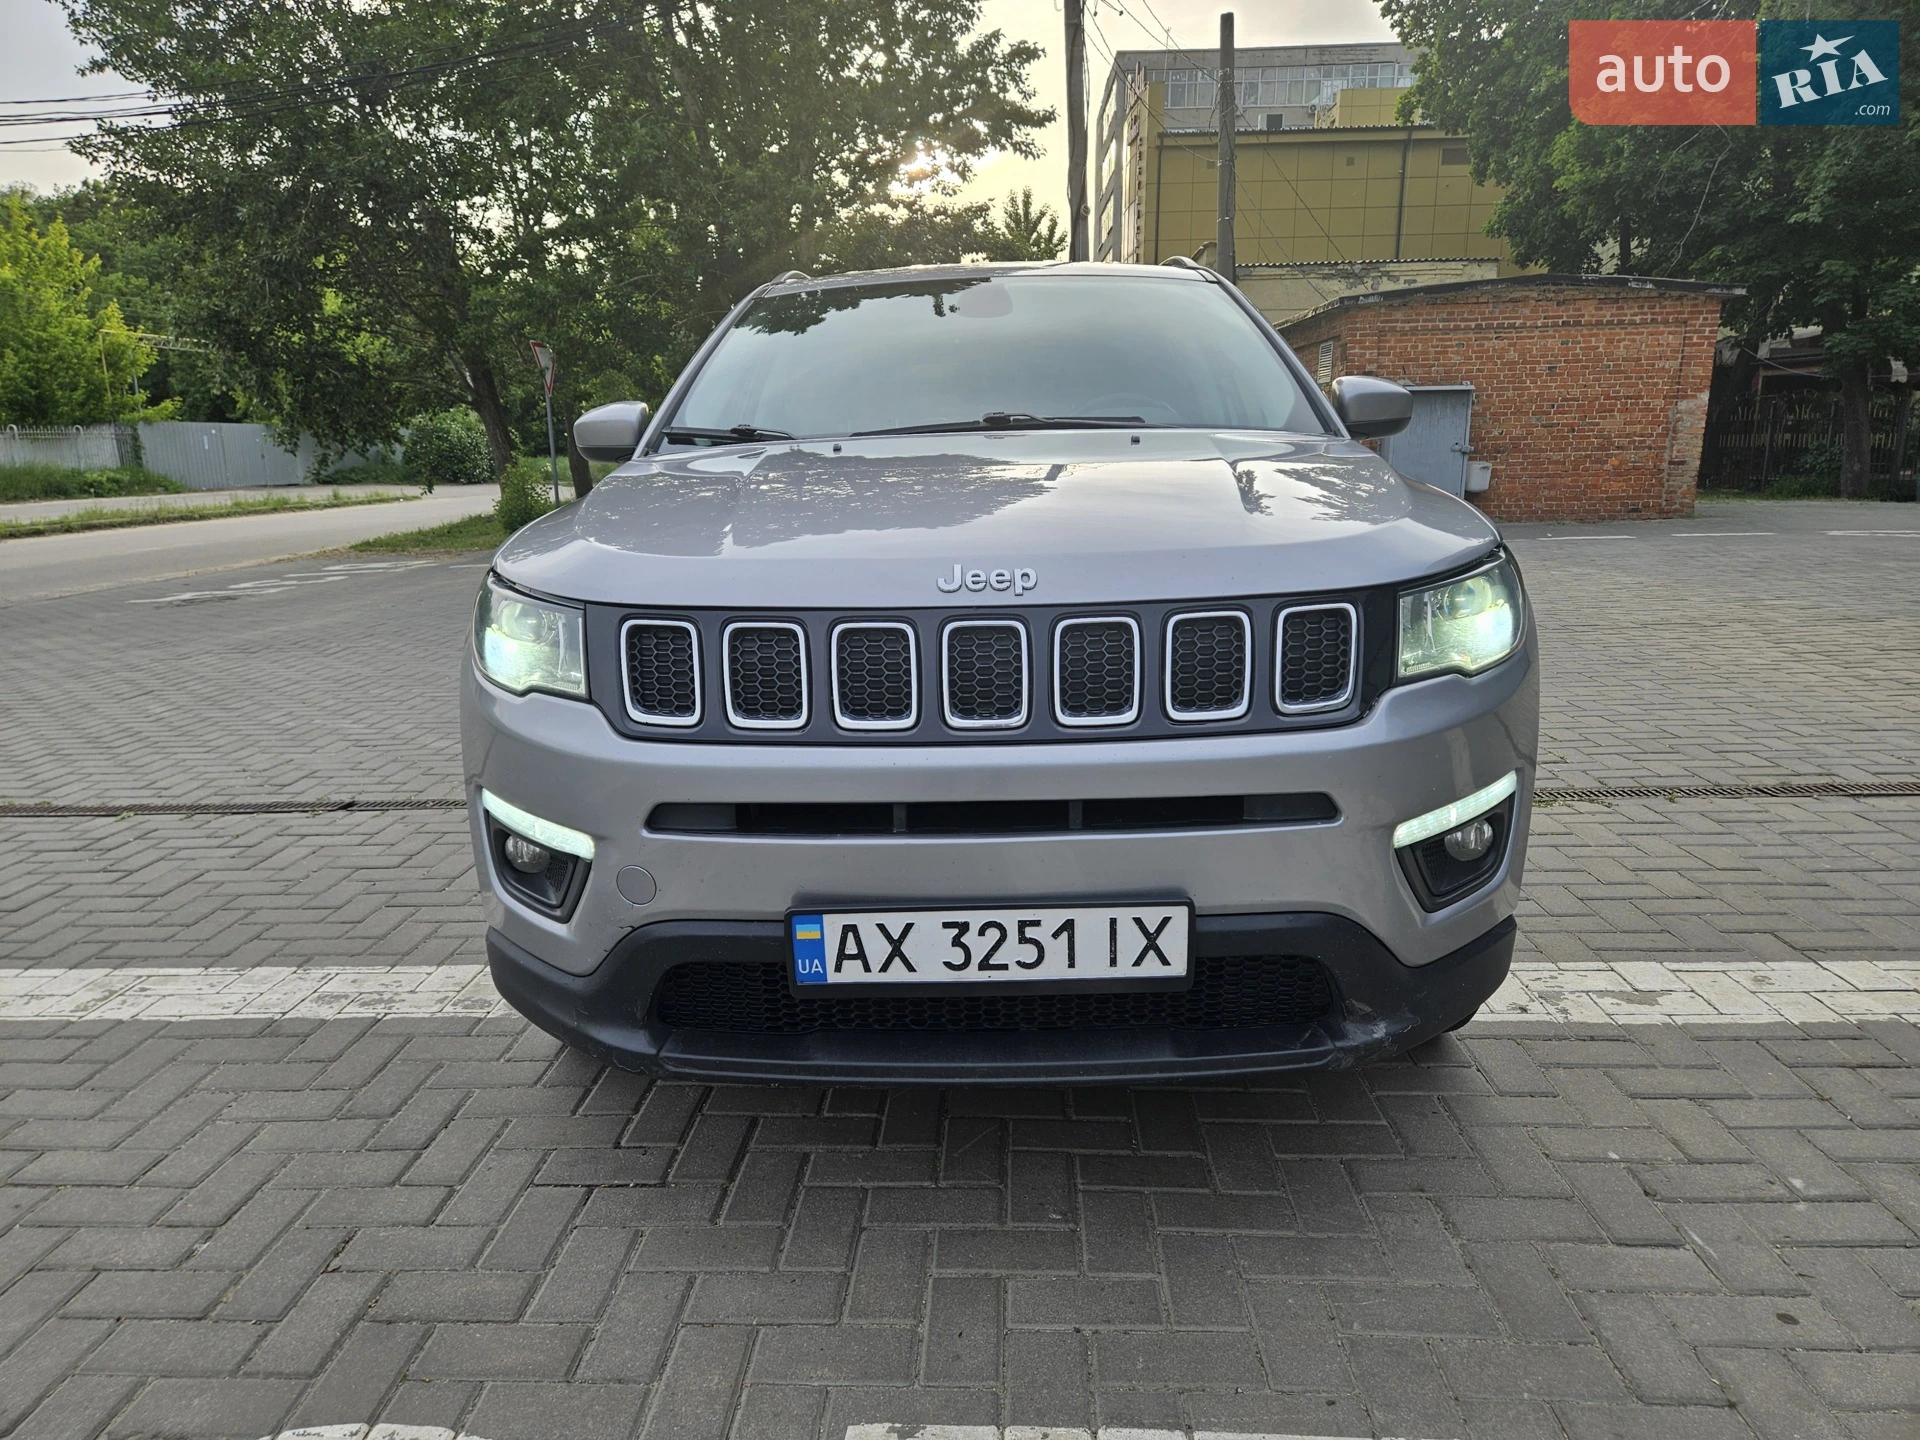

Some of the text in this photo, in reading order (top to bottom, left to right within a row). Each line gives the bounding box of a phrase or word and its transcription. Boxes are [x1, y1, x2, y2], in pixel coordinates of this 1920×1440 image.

[937, 564, 1038, 597] Jeep
[834, 916, 1173, 974] AX 3251 IX
[798, 959, 824, 974] UA
